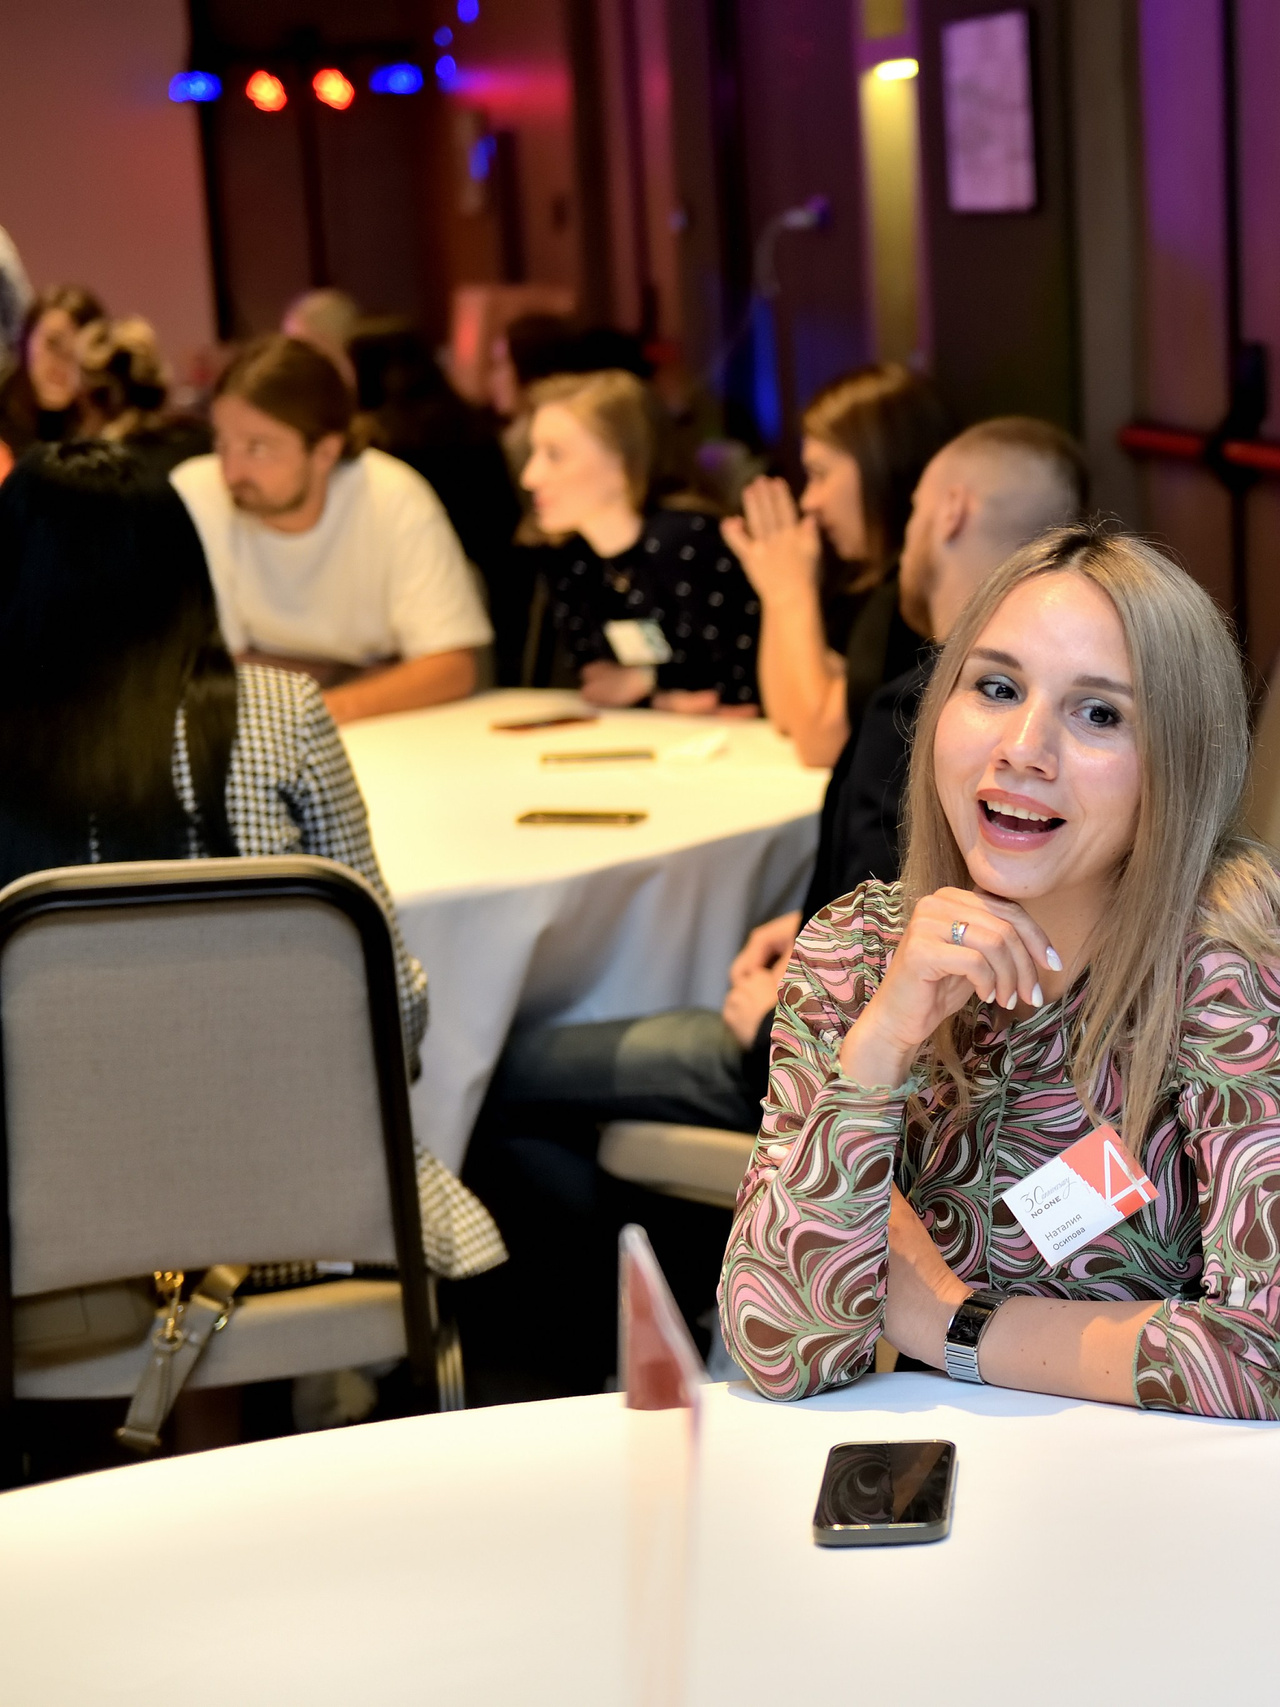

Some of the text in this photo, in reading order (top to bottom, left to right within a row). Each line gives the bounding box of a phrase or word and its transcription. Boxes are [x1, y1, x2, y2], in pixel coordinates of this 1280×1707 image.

[1104, 1140, 1150, 1205] 4
[1030, 1196, 1062, 1219] NO ONE
[1044, 1213, 1083, 1241] Наталия
[1052, 1227, 1086, 1251] Осипова
